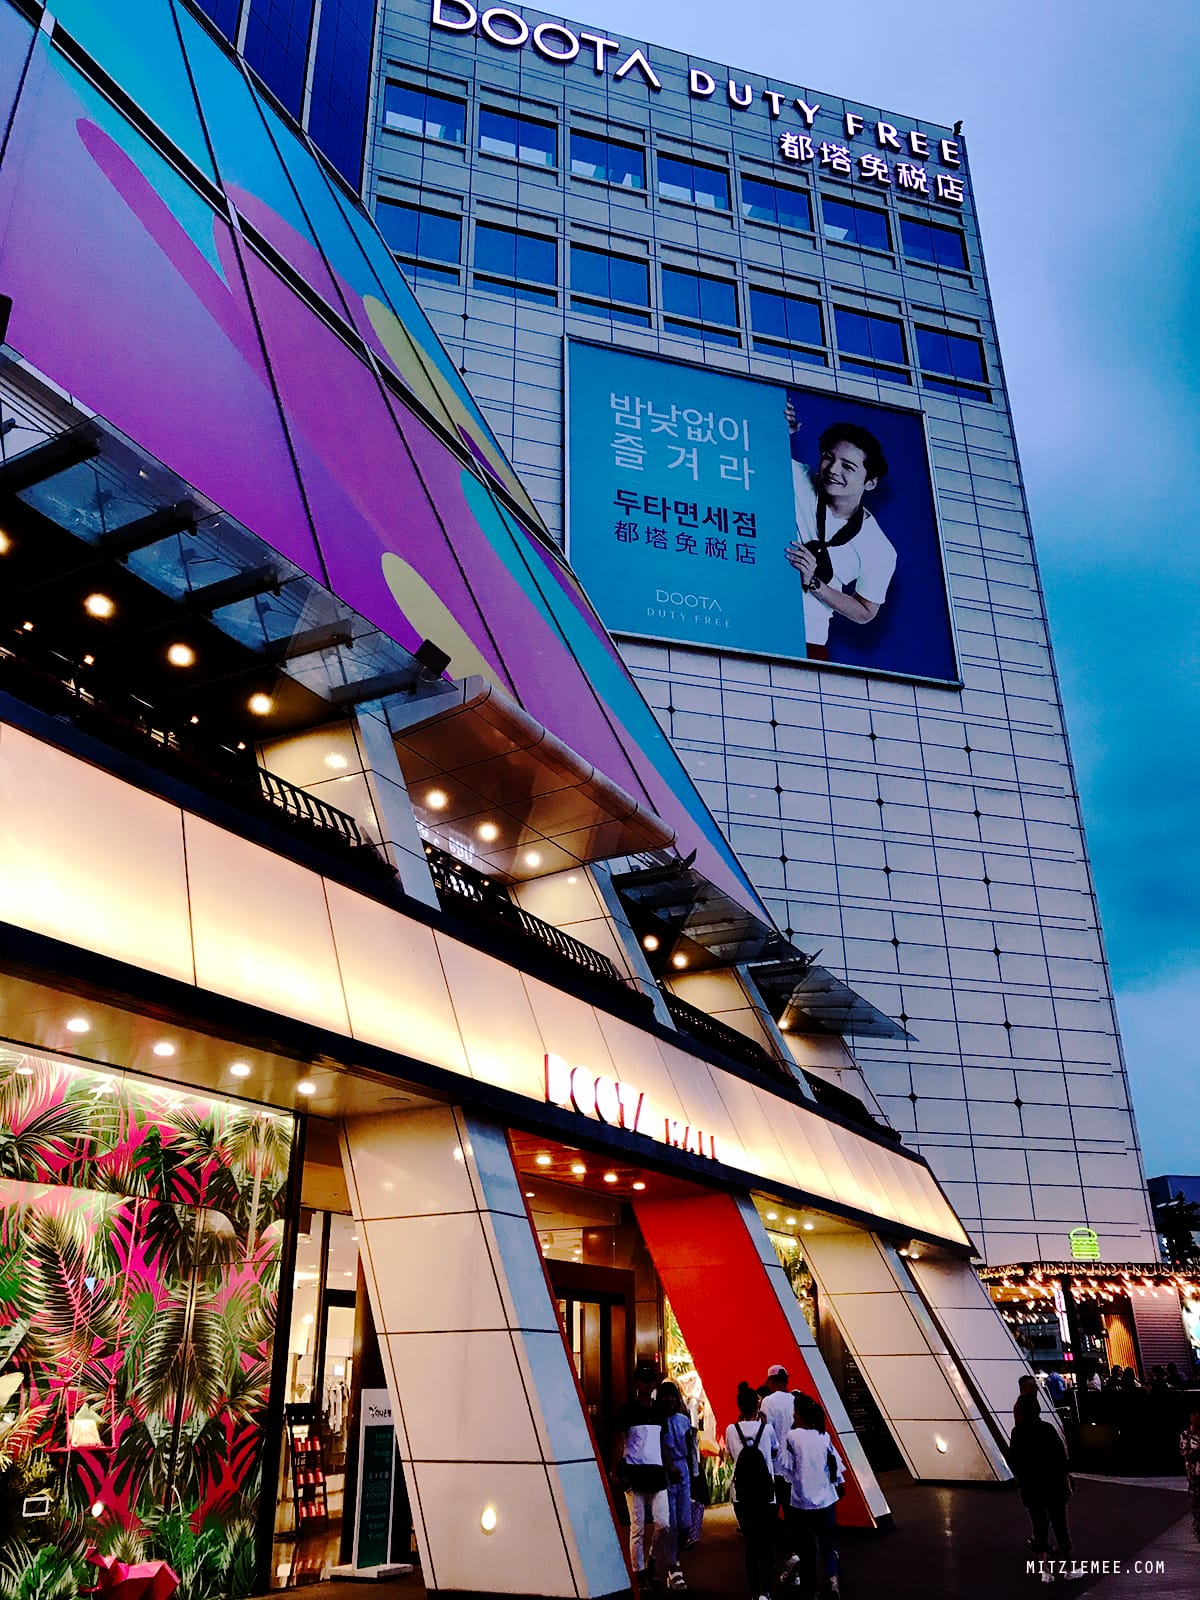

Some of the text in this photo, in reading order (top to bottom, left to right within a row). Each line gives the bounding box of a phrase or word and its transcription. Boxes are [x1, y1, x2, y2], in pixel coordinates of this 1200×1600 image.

[432, 0, 961, 168] DOOTA DUTY FREE
[779, 131, 965, 204] 都塔免税店
[610, 392, 750, 452] 밤낮없이
[613, 489, 757, 538] 두타면세점
[613, 520, 756, 564] 都塔免税店
[647, 607, 731, 628] DUTY FREE
[656, 589, 722, 612] DOOTA
